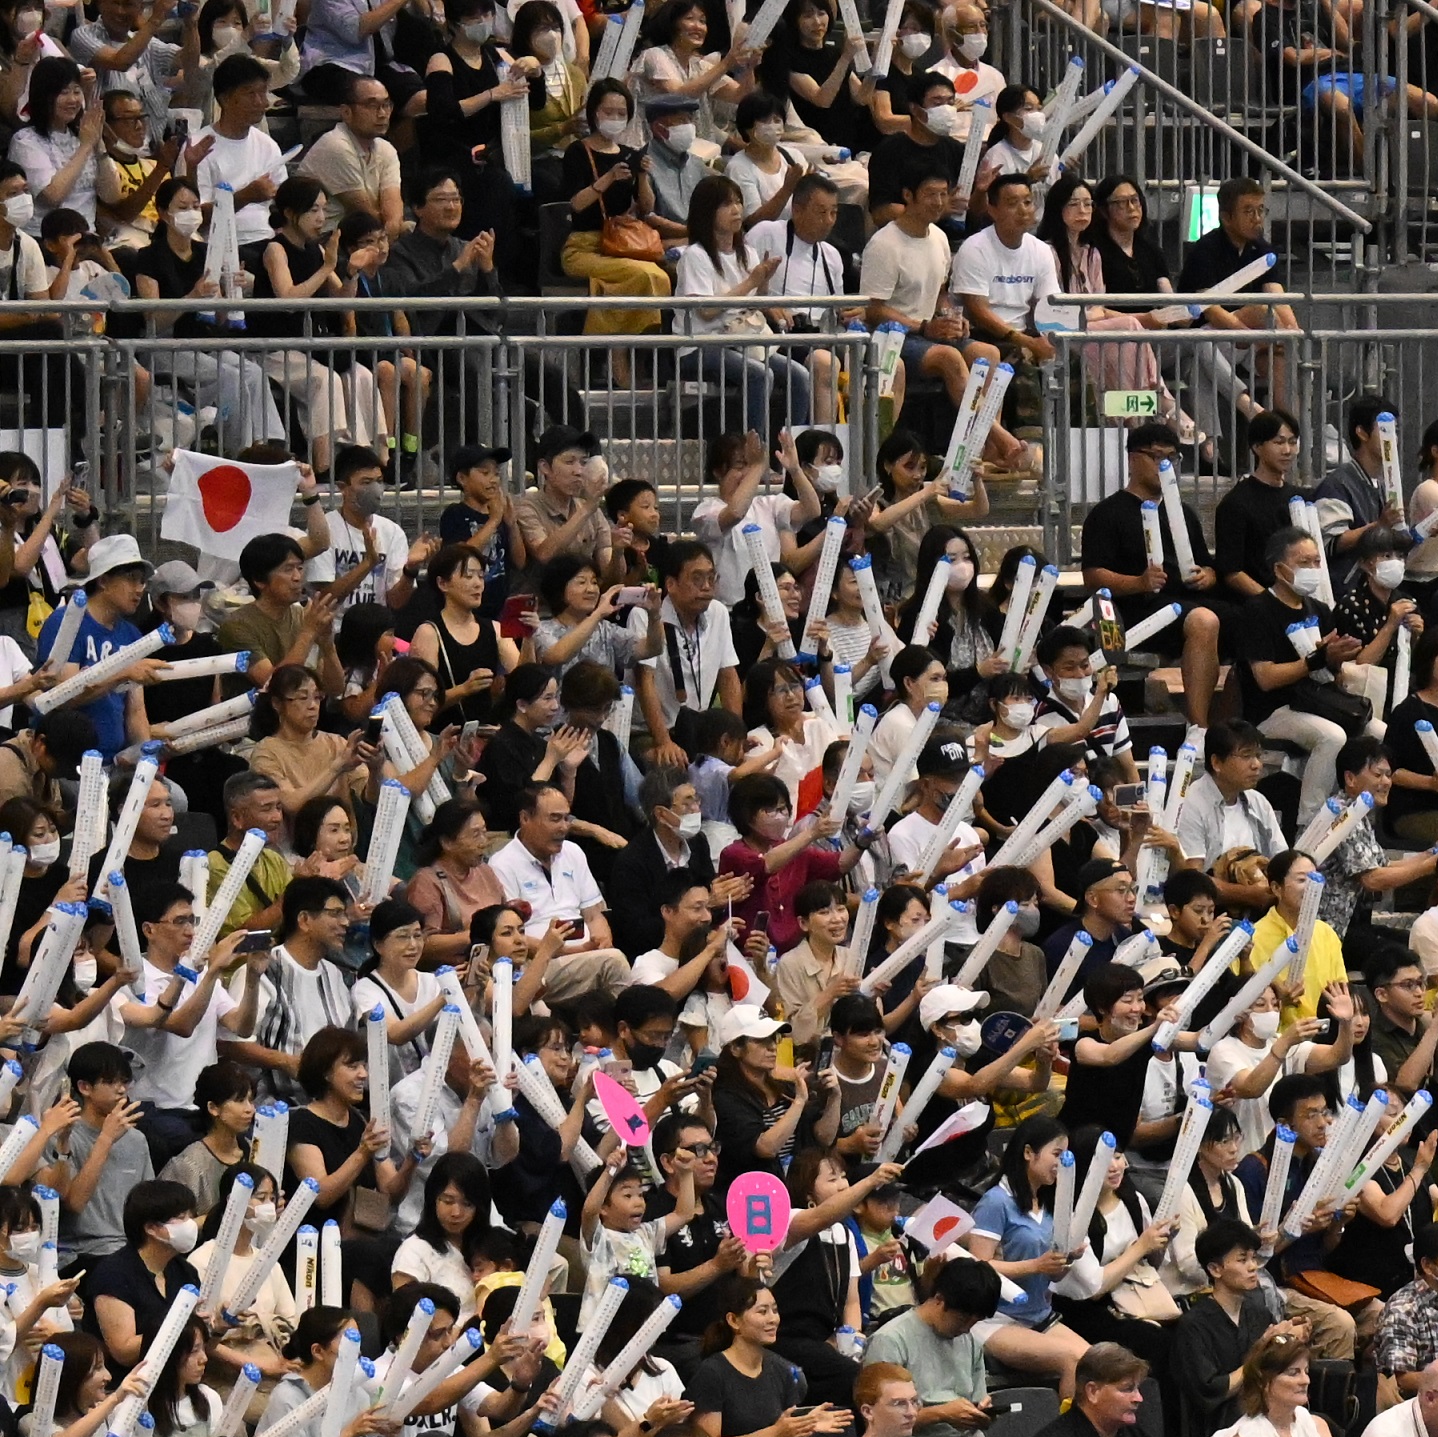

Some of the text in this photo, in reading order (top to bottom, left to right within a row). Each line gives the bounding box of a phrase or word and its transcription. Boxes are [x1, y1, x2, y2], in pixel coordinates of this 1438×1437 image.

[335, 548, 387, 564] WATR
[880, 1072, 896, 1099] Nikon
[746, 1194, 772, 1235] 日
[304, 1256, 316, 1288] Nikon
